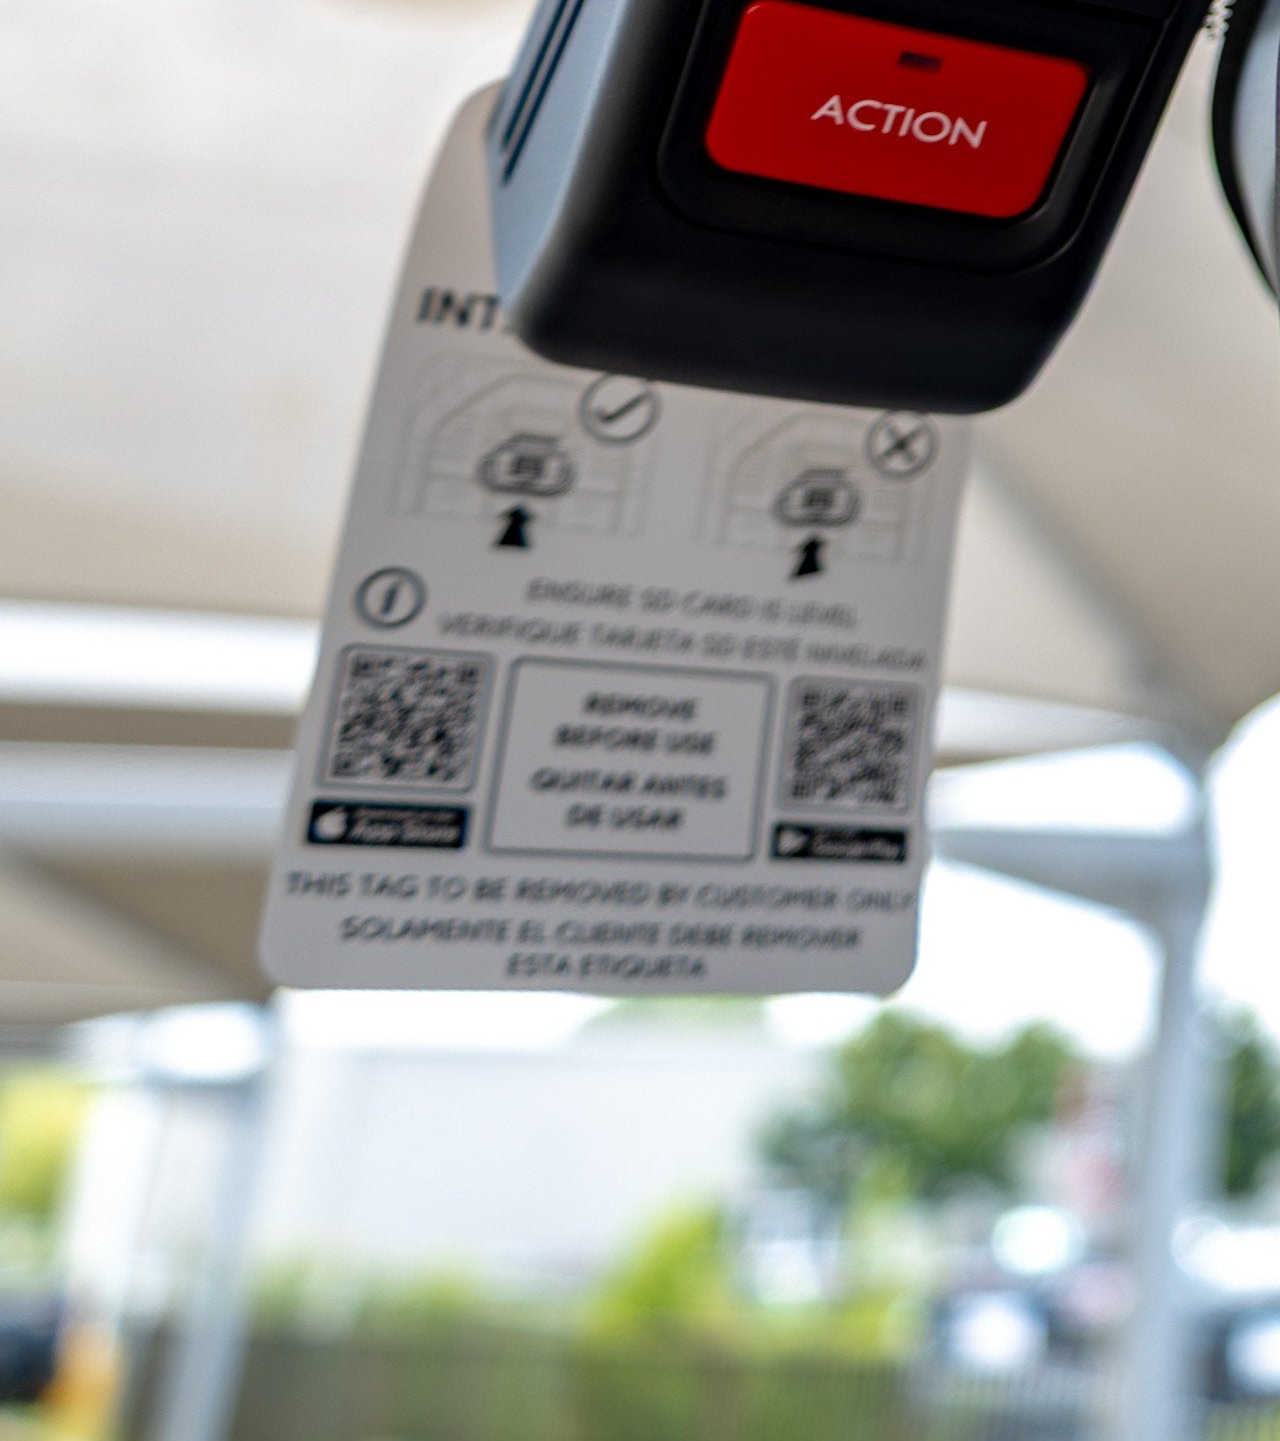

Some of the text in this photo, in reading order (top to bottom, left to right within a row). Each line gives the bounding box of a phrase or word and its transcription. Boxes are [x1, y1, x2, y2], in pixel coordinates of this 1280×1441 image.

[810, 94, 988, 149] ACTION
[417, 285, 501, 332] INT
[526, 576, 633, 608] ENSURE
[682, 590, 750, 621] CARD
[440, 612, 583, 646] VERIFIQUE
[584, 692, 698, 722] REMOVE
[555, 724, 716, 755] BEFORE USE
[531, 767, 727, 800] QUITAR ANTES
[566, 805, 683, 831] DE USAR
[287, 870, 350, 899] THIS
[358, 873, 418, 900] TAG
[427, 874, 467, 901] TO
[474, 876, 507, 901] BE
[514, 877, 650, 905] REMOVED
[657, 879, 692, 904] BY
[697, 882, 838, 909] CUSTOMER
[340, 914, 862, 951] SOLAMENTE EL CLIENTE DEBE REMOVER
[505, 953, 706, 981] ESTA ETIQUETA
